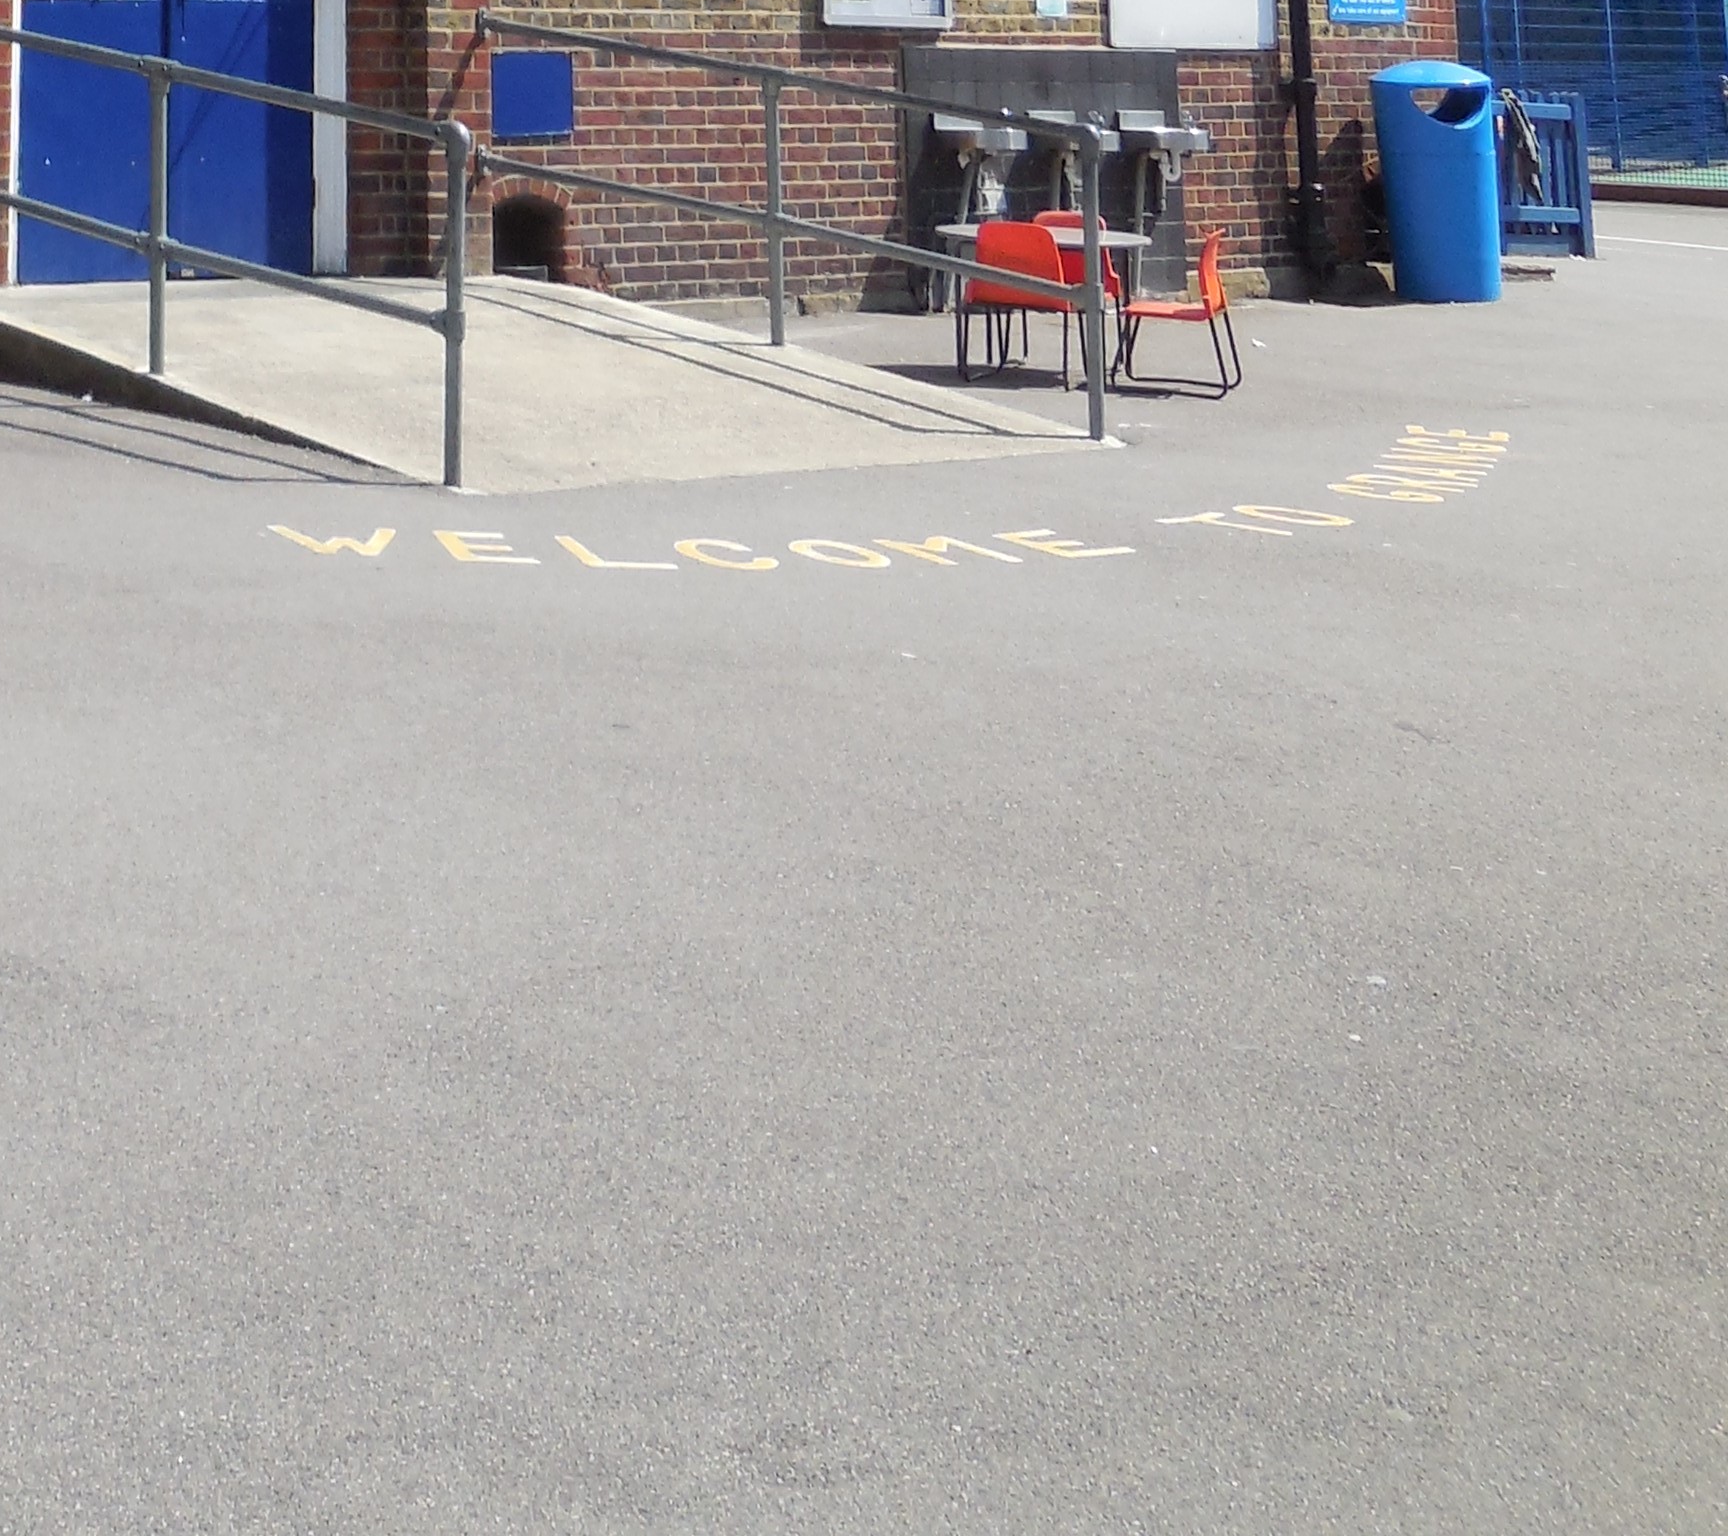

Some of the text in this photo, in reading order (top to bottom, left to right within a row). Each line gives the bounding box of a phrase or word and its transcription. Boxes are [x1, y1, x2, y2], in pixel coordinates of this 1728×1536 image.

[267, 424, 1511, 571] WELCOME TO GRANGE
